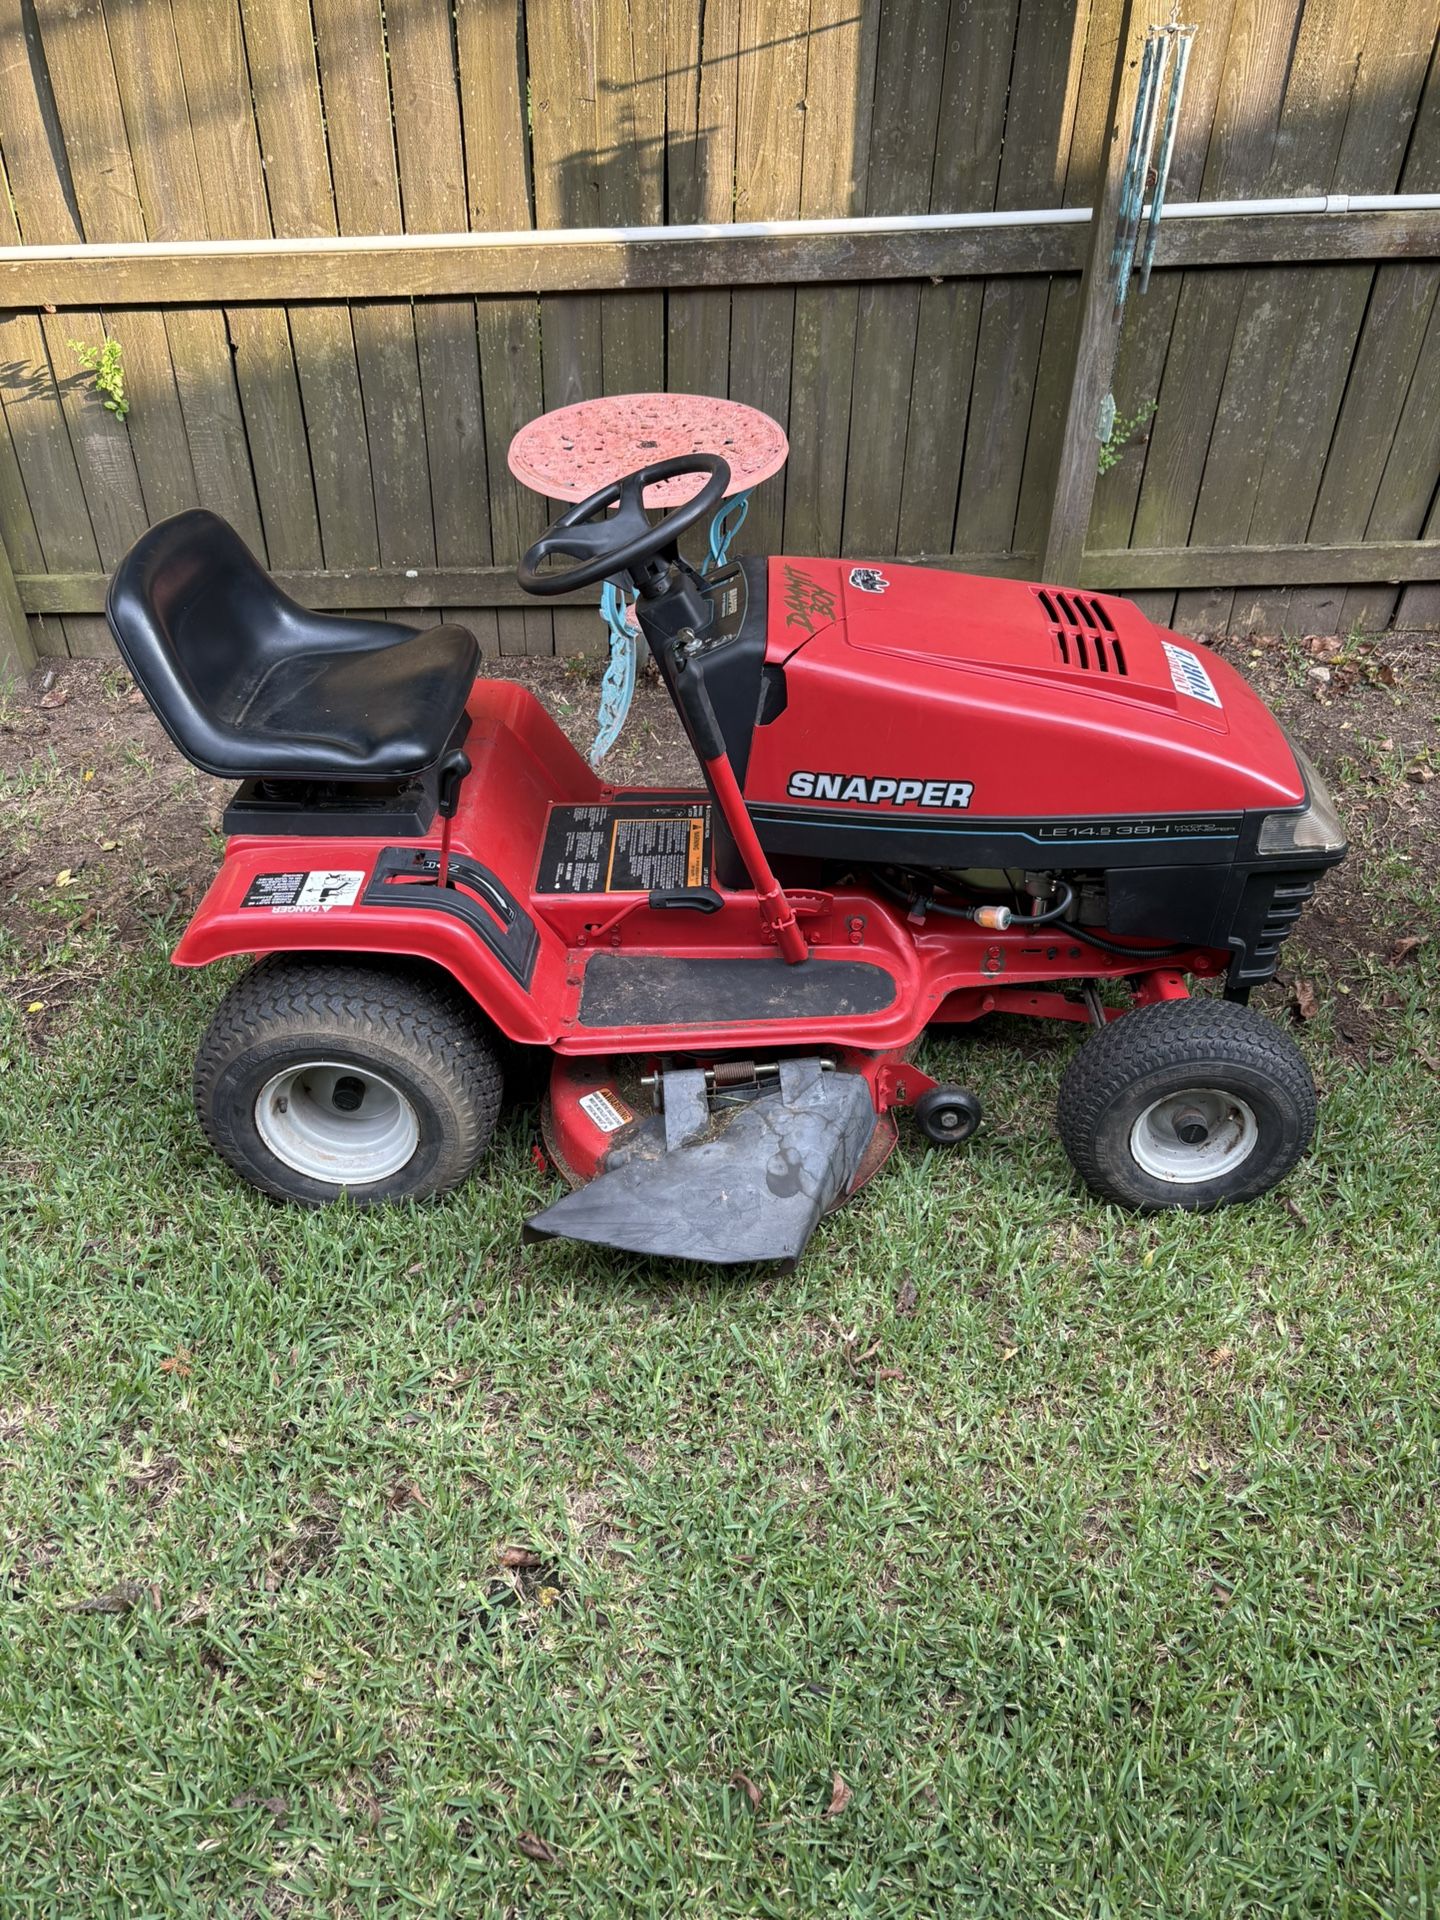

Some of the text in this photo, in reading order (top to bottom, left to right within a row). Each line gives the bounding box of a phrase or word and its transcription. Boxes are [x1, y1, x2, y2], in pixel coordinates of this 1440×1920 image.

[1172, 648, 1216, 704] FORCE
[788, 771, 974, 808] SNAPPER
[1039, 825, 1169, 837] LE14.5 38H
[271, 905, 320, 914] DANGER
